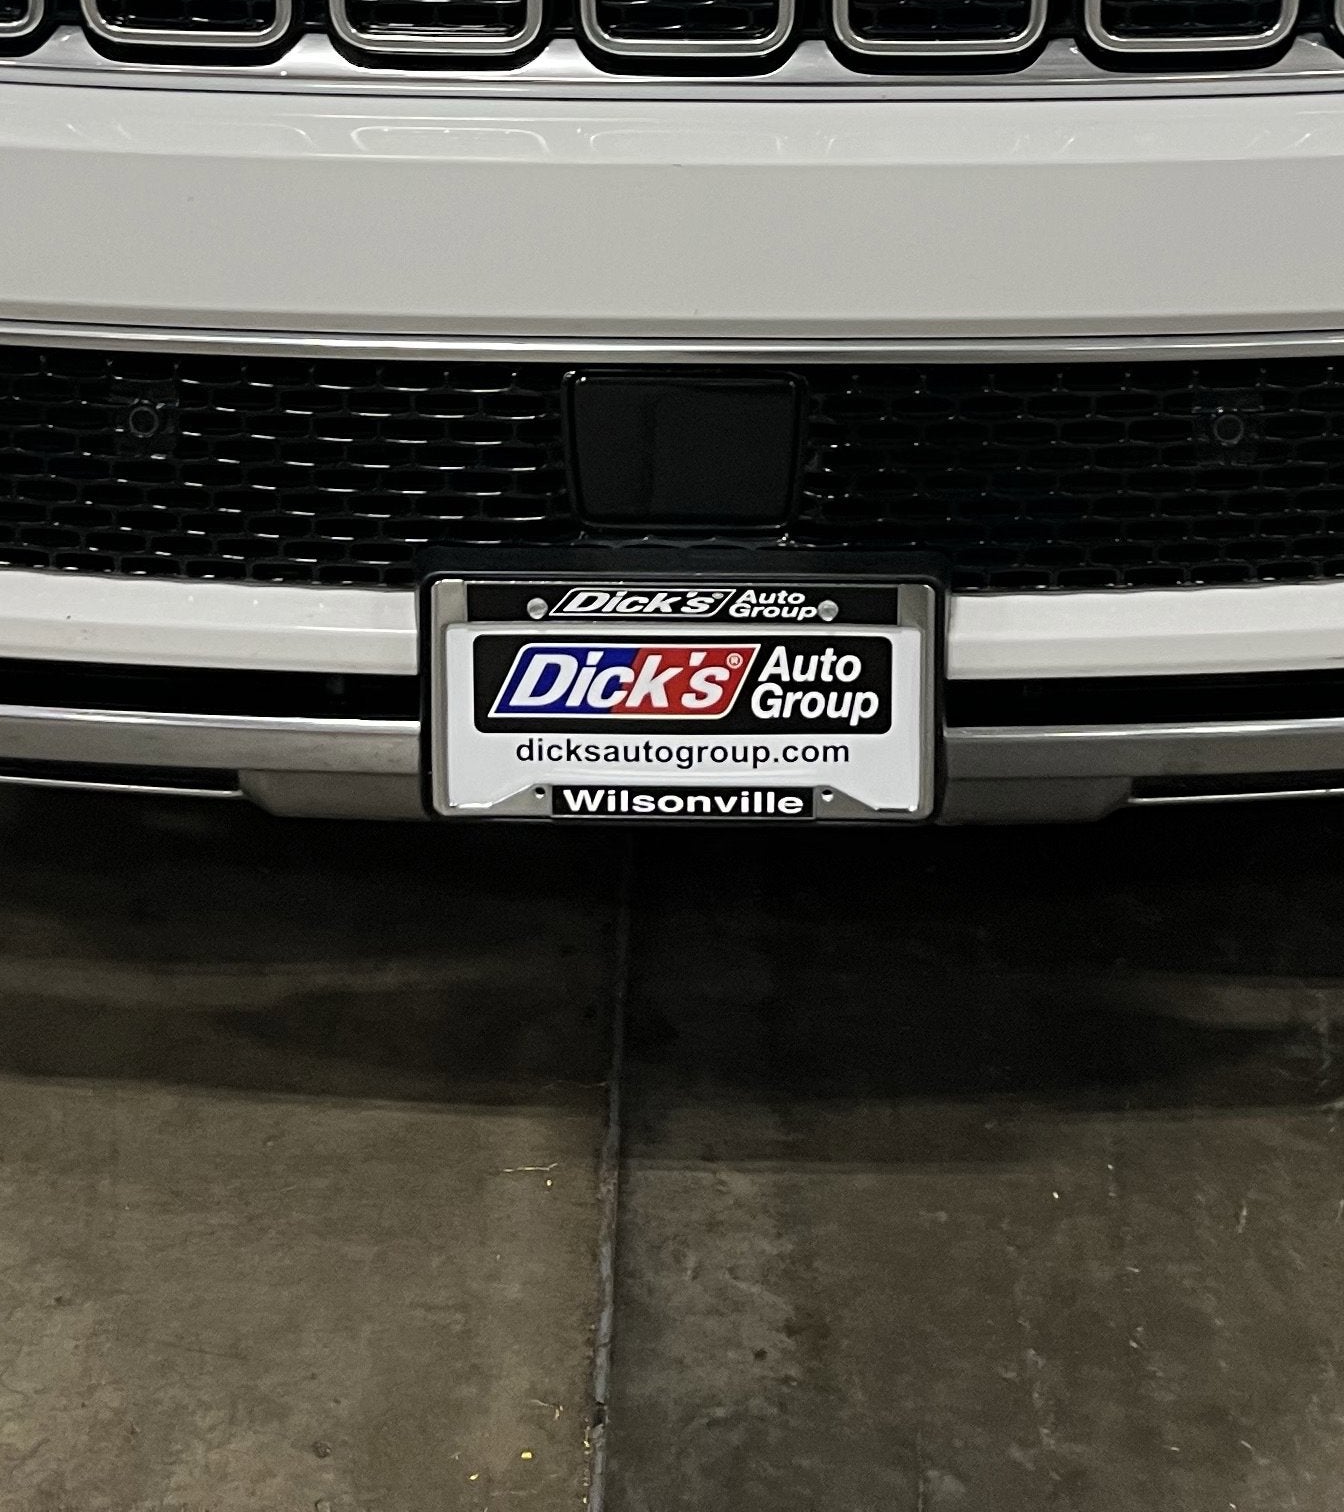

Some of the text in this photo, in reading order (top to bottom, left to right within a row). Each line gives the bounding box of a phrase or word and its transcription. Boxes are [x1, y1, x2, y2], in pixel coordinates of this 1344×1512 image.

[734, 589, 805, 605] Auto
[729, 602, 817, 621] Group
[759, 647, 861, 682] Auto
[751, 682, 879, 726] Group
[516, 738, 850, 769] dicksautogroup.com
[562, 790, 804, 813] Wilsonville
